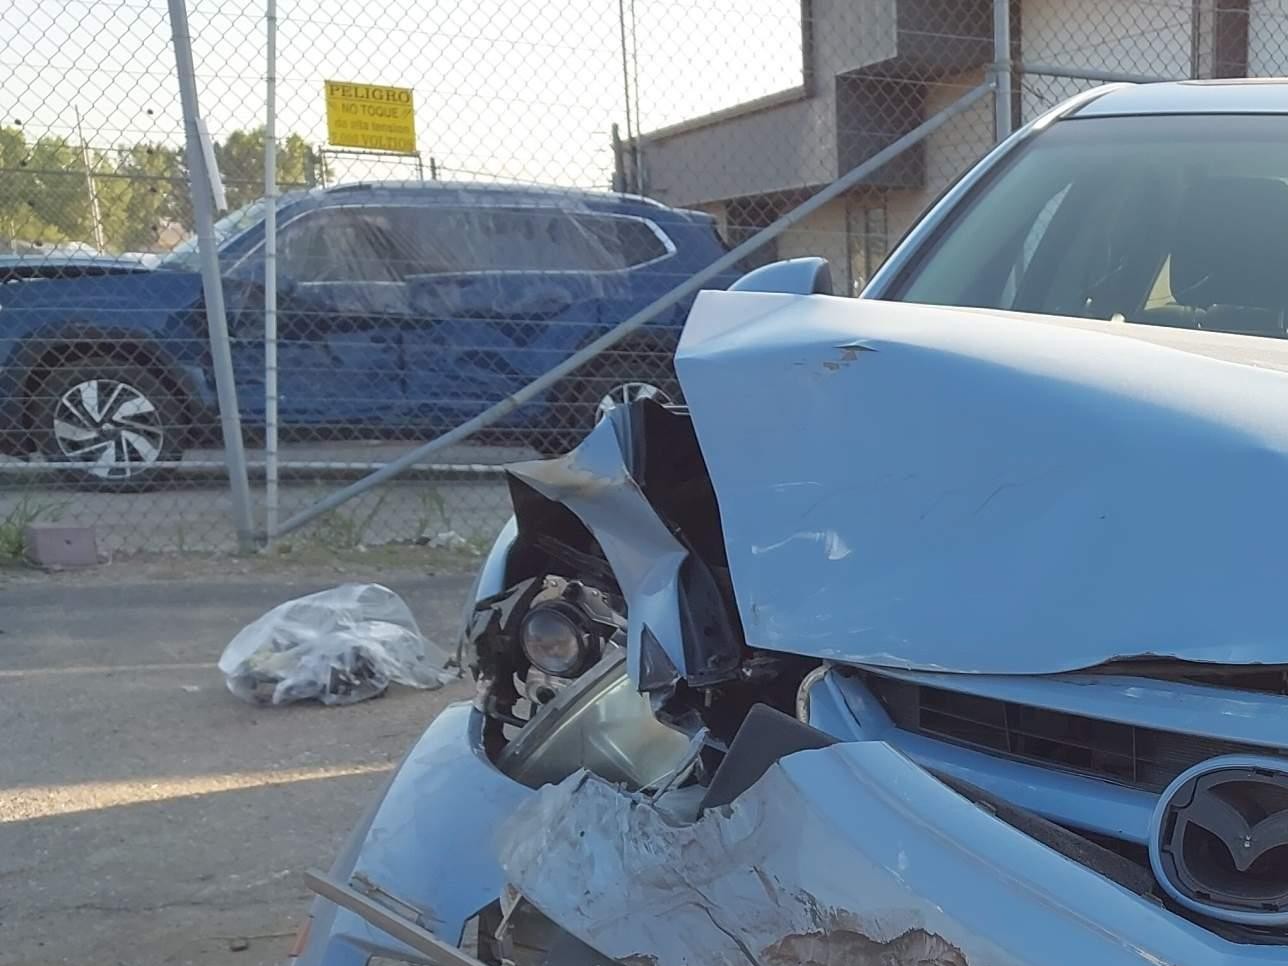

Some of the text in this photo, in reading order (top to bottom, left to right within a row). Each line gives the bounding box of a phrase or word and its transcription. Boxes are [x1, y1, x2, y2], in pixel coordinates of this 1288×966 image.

[328, 84, 410, 104] PELIGRO
[341, 103, 399, 118] NO TOQUE
